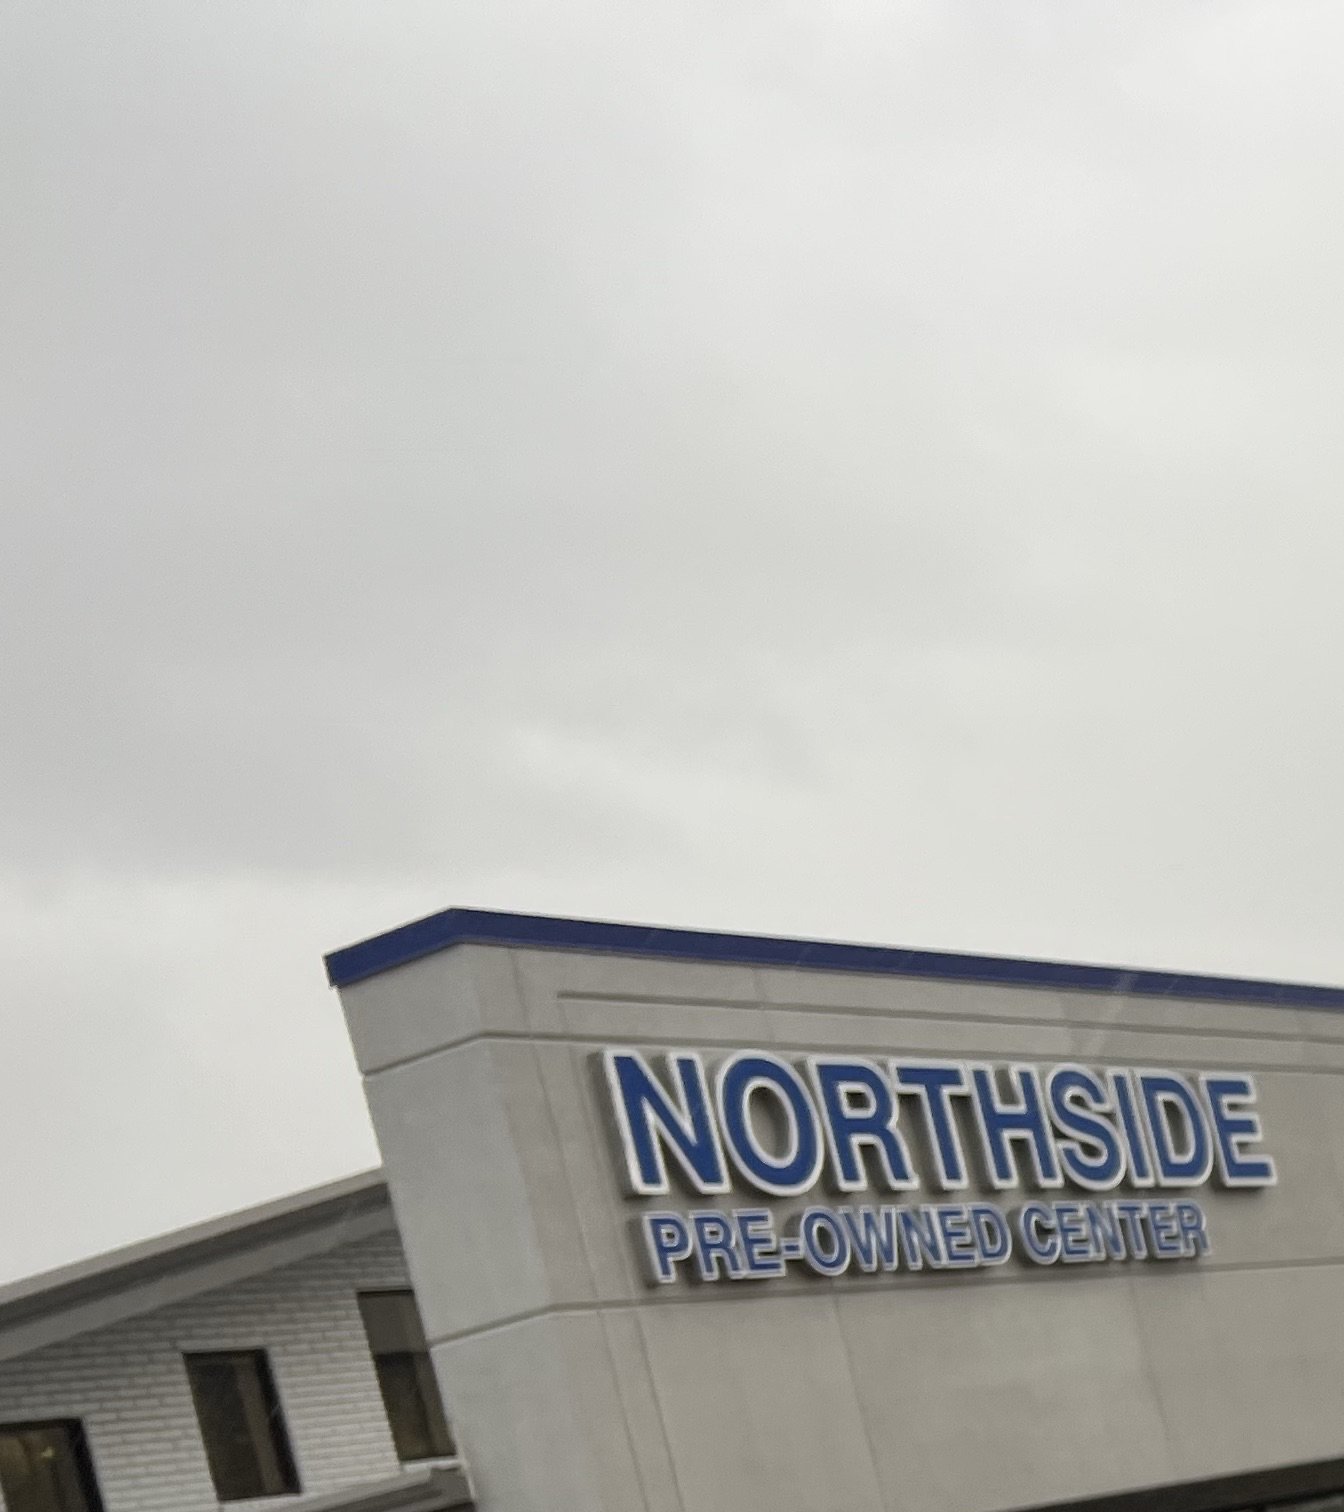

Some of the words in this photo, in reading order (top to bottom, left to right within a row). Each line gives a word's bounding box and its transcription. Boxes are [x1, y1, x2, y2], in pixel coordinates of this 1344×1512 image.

[603, 1047, 1277, 1197] NORTHSIDE
[642, 1201, 1012, 1282] PRE-OWNED
[1019, 1200, 1211, 1265] CENTER
